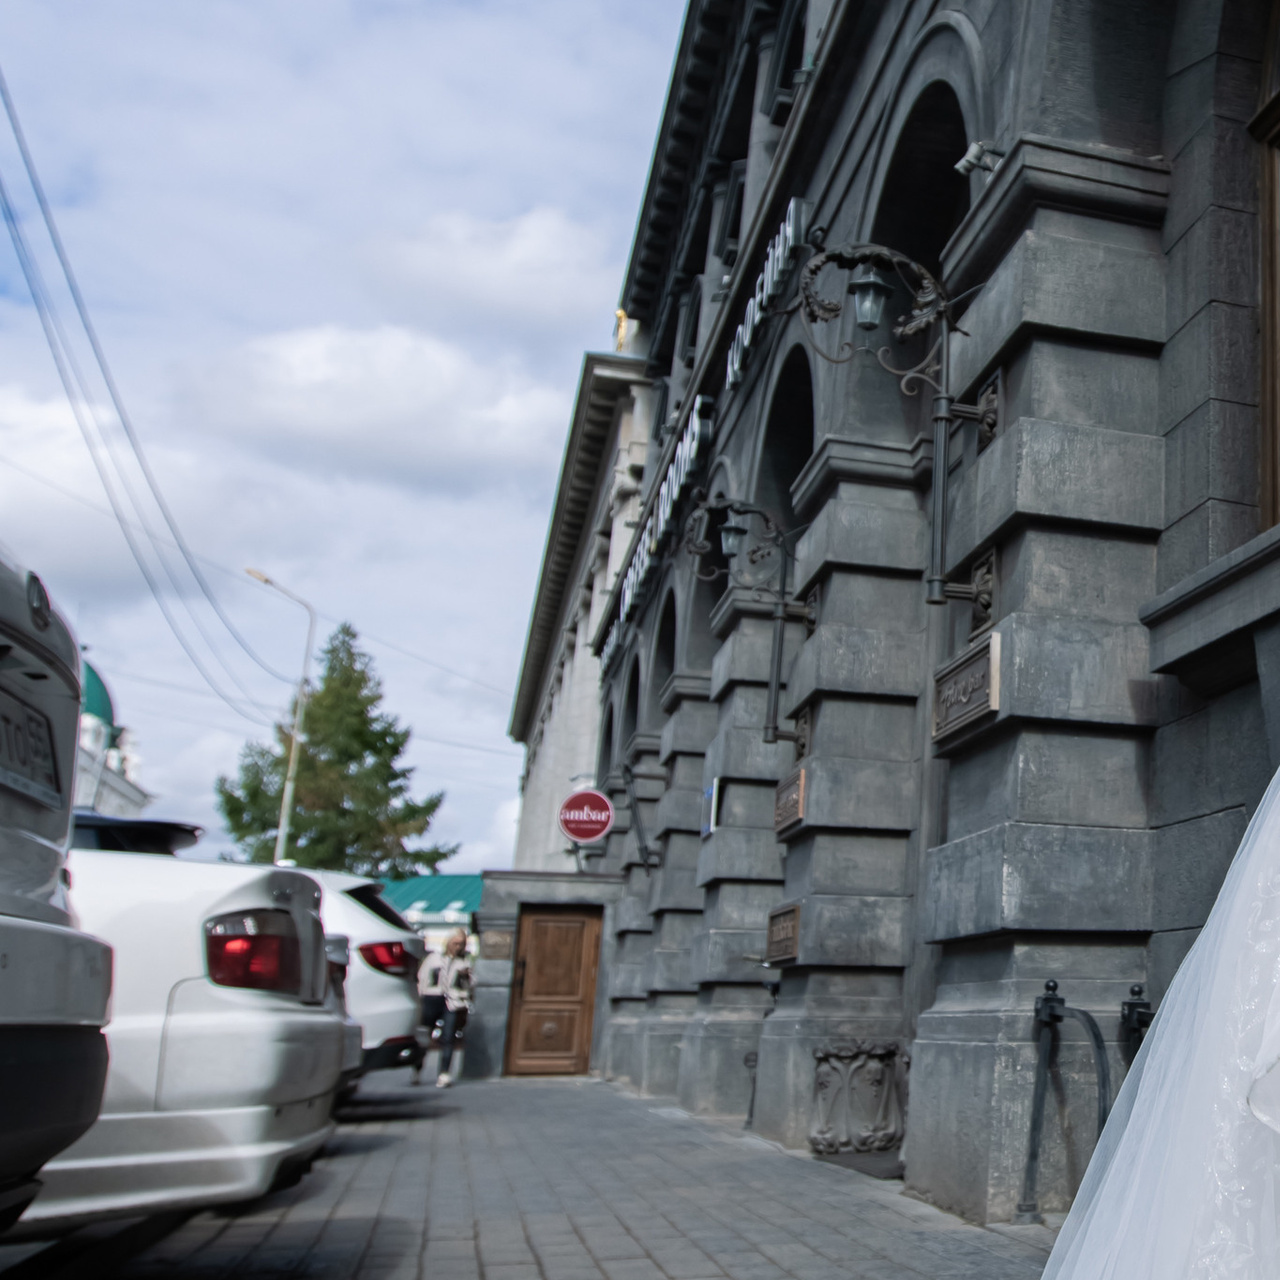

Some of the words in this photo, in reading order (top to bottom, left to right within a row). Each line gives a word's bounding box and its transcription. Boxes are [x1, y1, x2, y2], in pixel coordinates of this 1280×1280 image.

[725, 196, 801, 391] КОФЕЙНЯ
[658, 394, 703, 539] ROOMS
[560, 805, 610, 822] ambar
